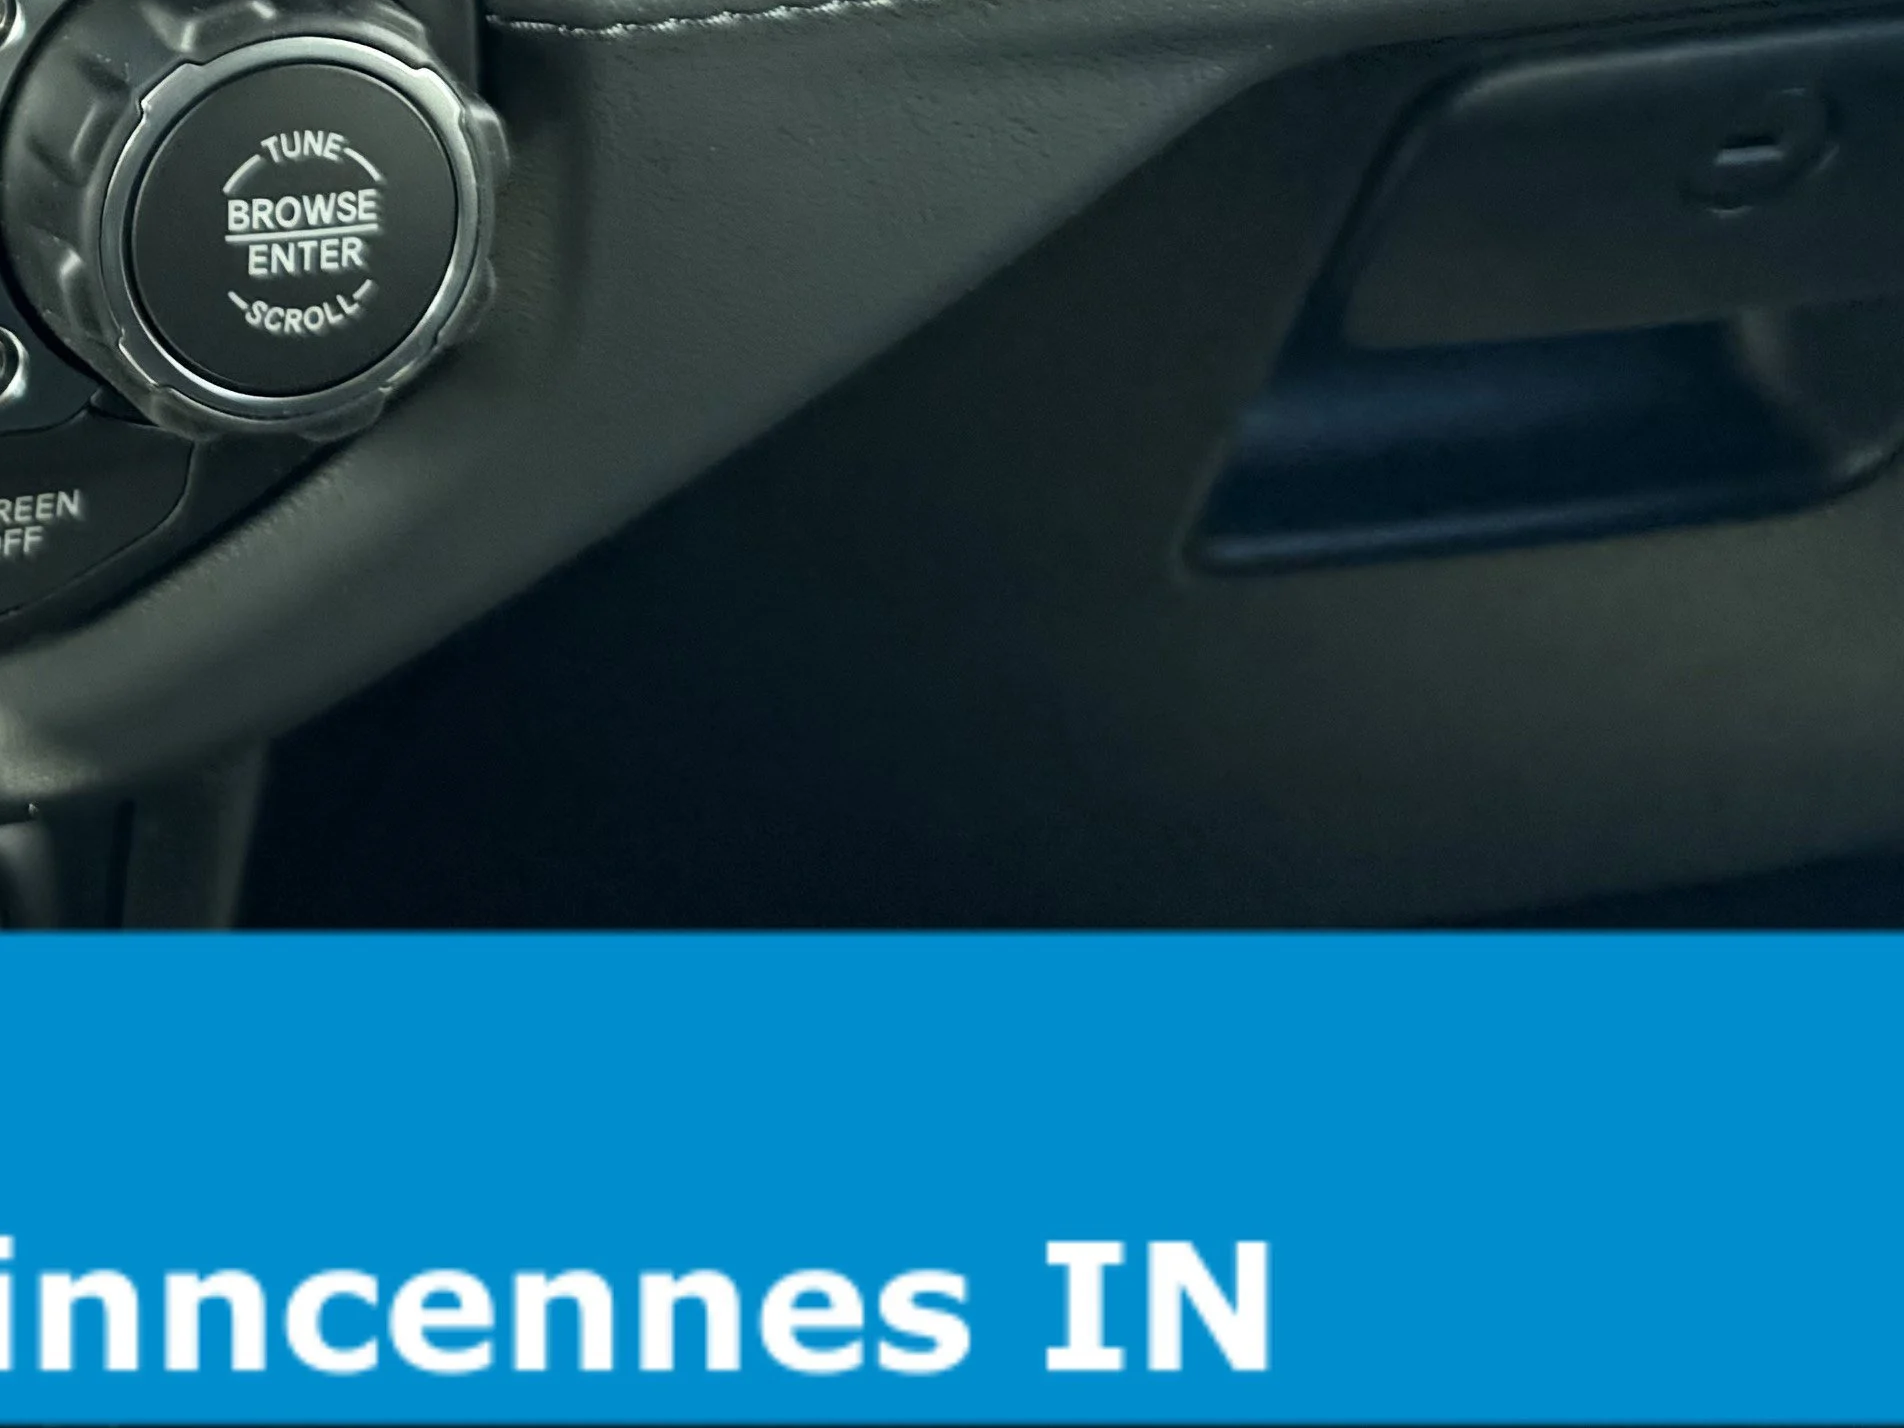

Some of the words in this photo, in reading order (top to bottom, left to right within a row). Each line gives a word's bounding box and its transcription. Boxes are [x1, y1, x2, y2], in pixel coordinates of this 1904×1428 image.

[261, 129, 345, 162] TUNE
[227, 189, 379, 232] BROWSE
[248, 236, 366, 276] ENTER
[245, 293, 359, 336] SCROLL
